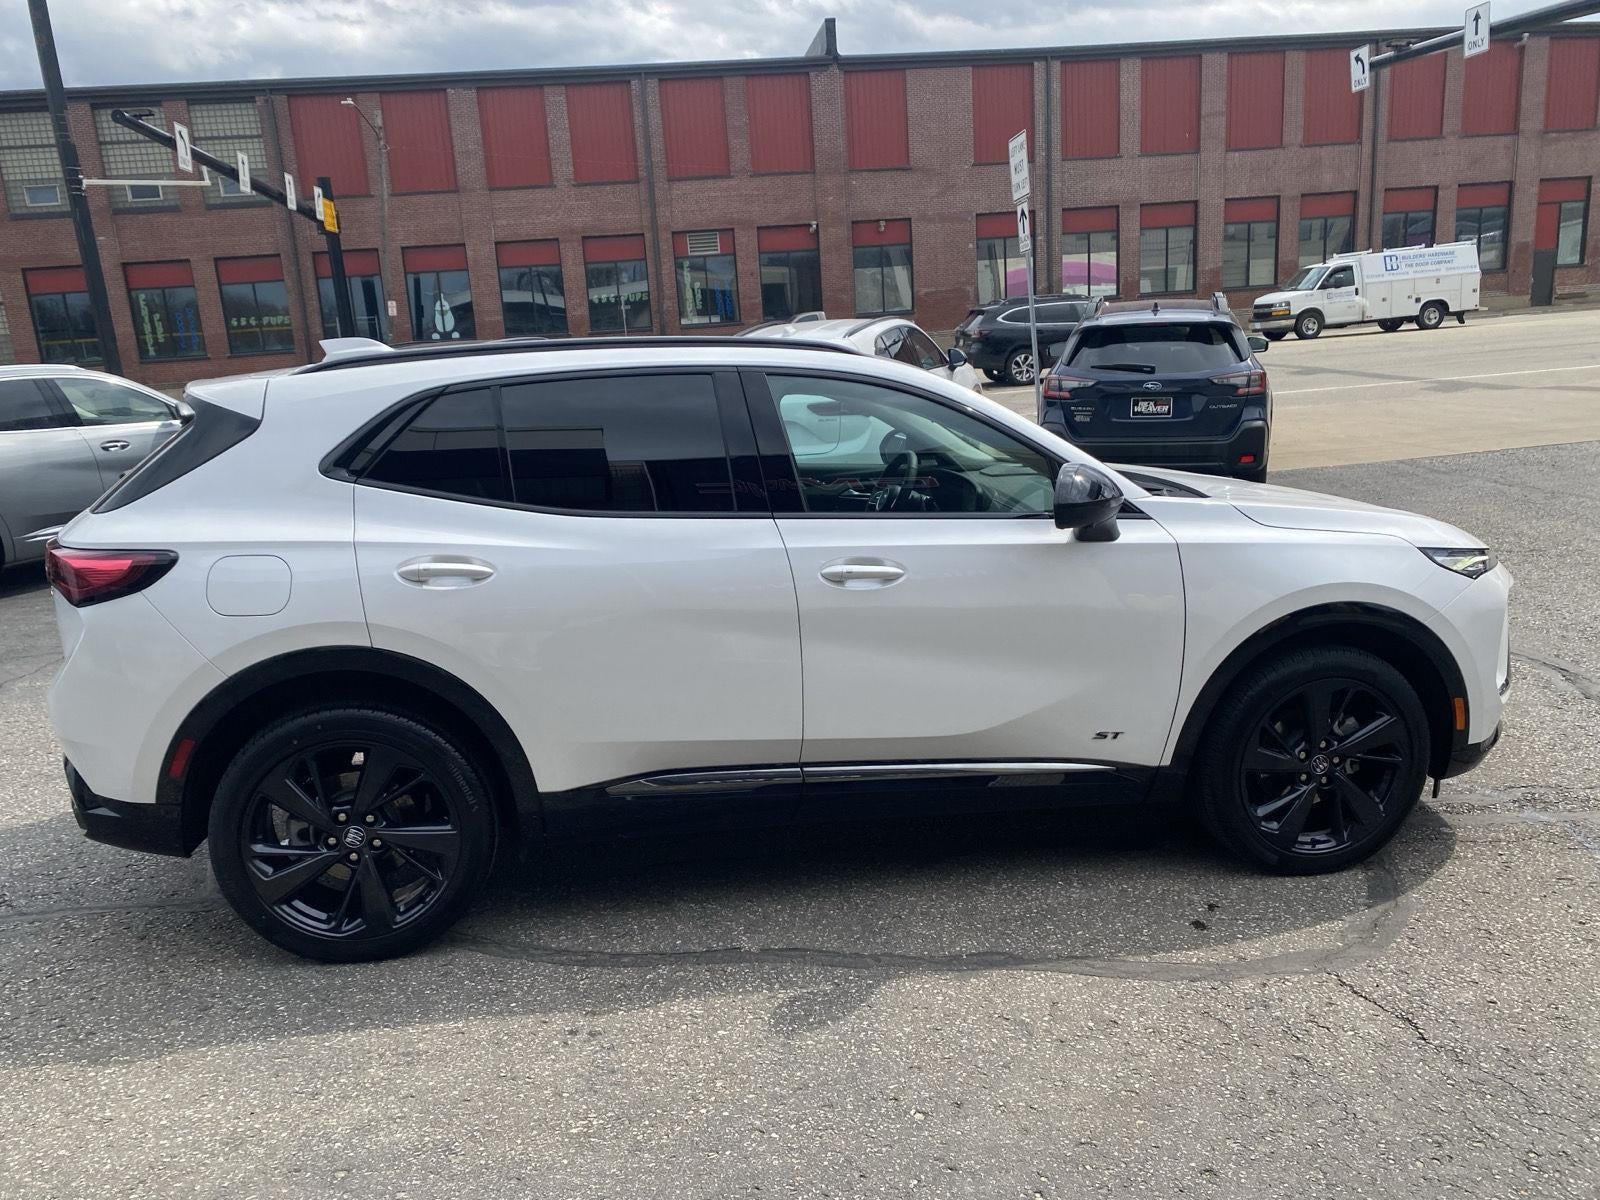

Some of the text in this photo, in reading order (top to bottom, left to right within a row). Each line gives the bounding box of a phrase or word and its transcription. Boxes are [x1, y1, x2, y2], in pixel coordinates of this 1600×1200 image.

[1467, 37, 1486, 50] ONLY
[1353, 77, 1368, 89] ONLY
[1091, 731, 1125, 740] ST
